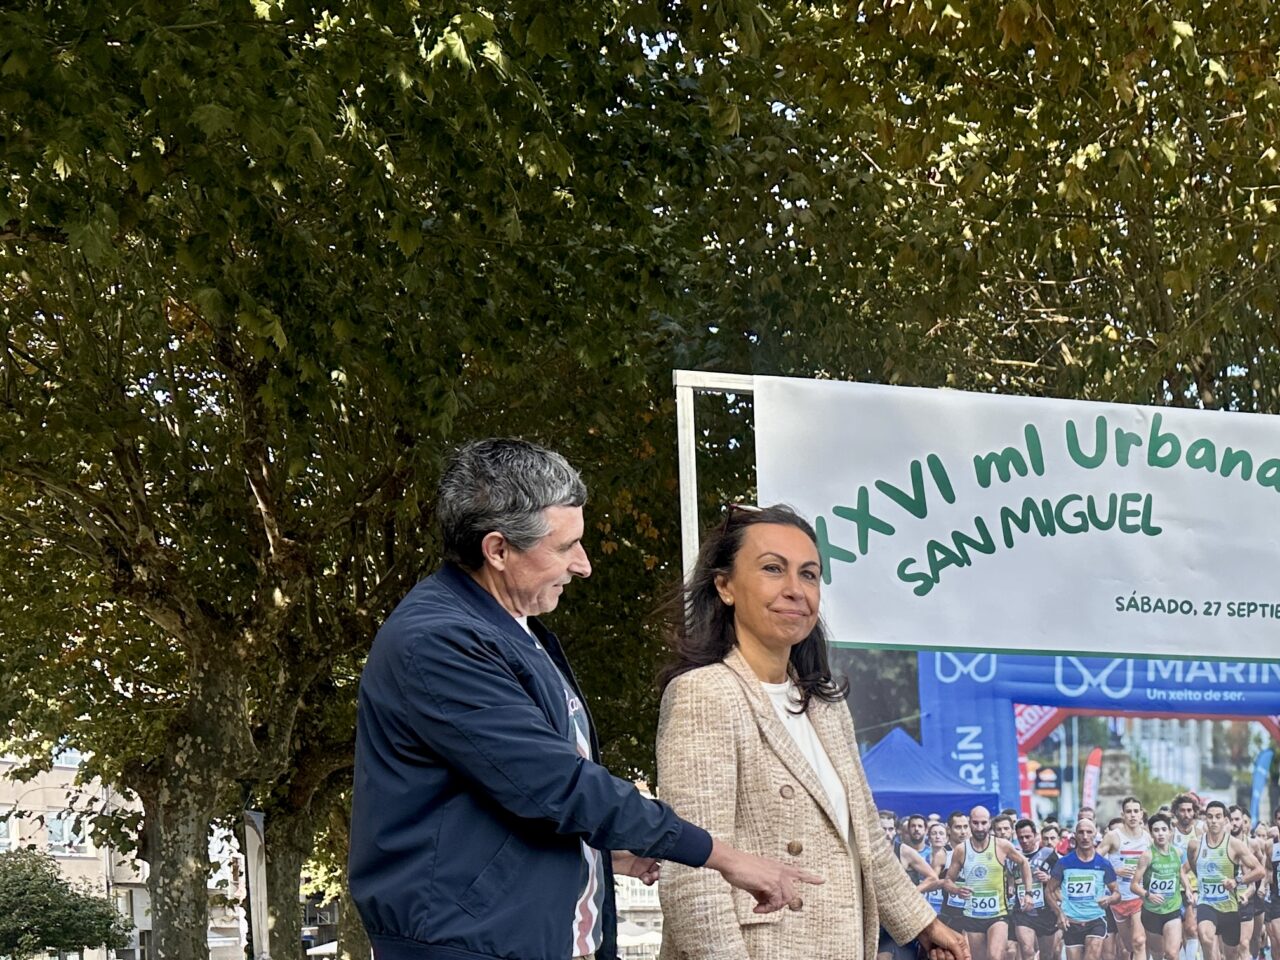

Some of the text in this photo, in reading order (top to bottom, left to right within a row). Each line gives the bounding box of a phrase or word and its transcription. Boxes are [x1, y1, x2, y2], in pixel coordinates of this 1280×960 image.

[897, 493, 1163, 596] SAN MIGUEL
[1115, 590, 1197, 616] SÁBADO,
[1203, 601, 1222, 617] 27
[1146, 688, 1167, 700] Un
[1168, 688, 1202, 701] xeito
[1204, 689, 1222, 701] de
[1067, 882, 1092, 894] 527
[1151, 880, 1174, 891] 602
[1203, 884, 1226, 895] 570
[972, 897, 997, 909] 560
